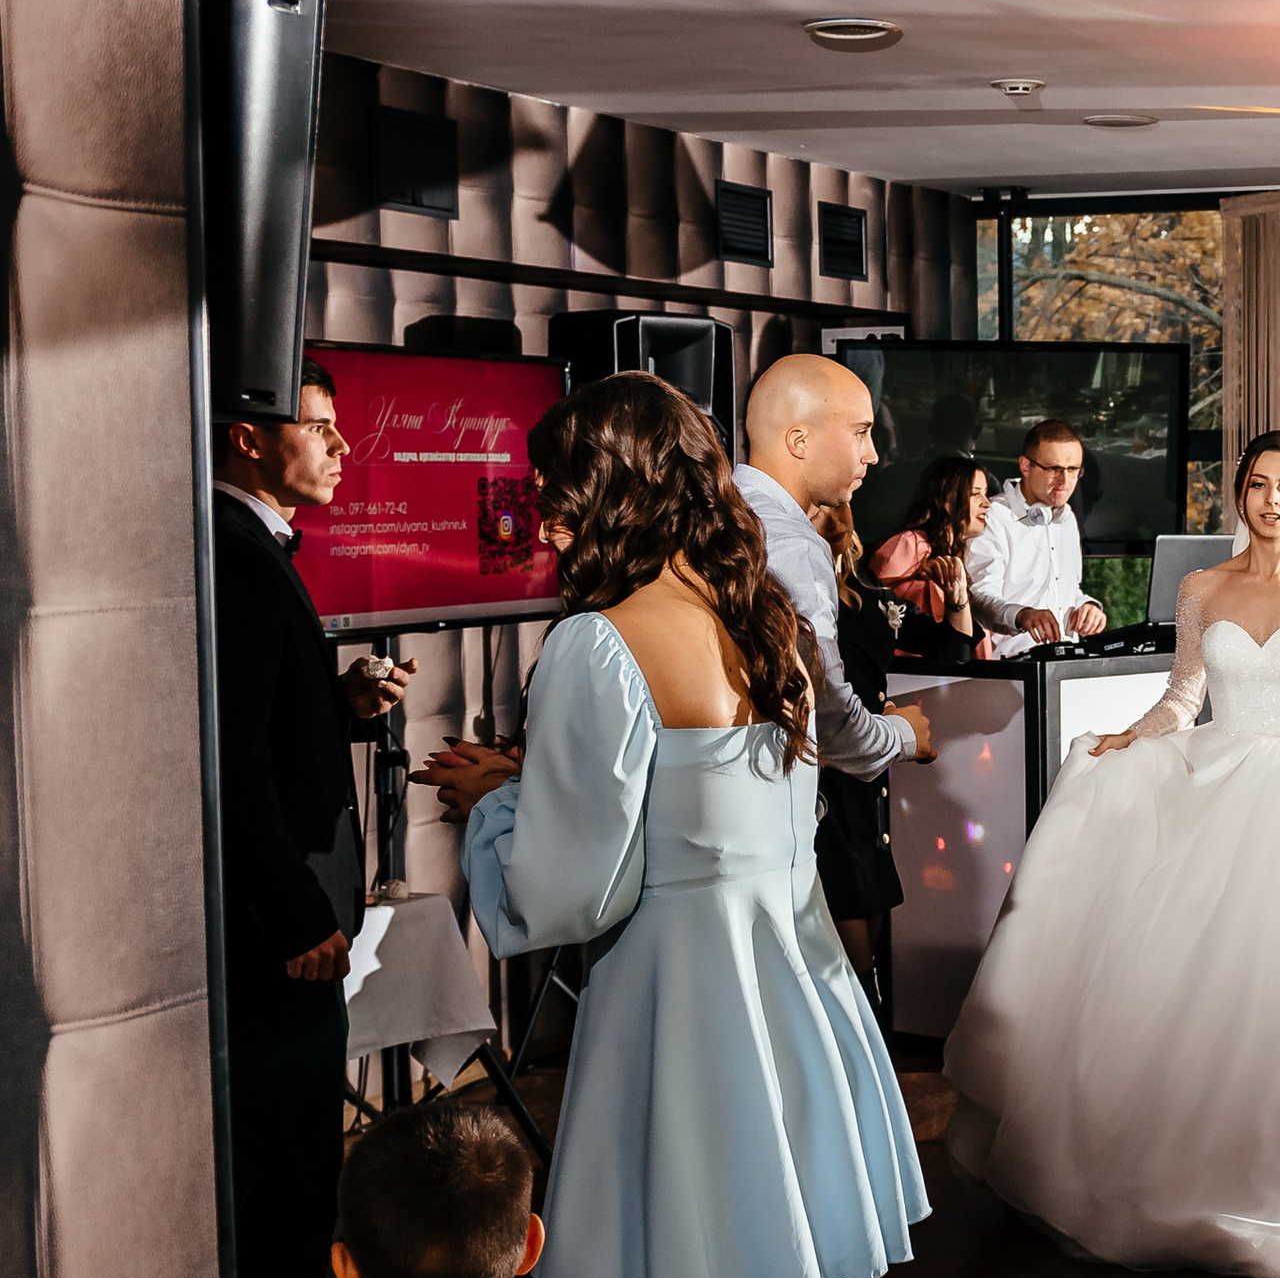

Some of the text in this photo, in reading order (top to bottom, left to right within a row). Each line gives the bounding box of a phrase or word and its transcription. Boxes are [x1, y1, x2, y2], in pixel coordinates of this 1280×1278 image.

[329, 502, 408, 516] тел. 097-661-72-42
[329, 519, 467, 537] instagram.com/ulyana_kushniruk
